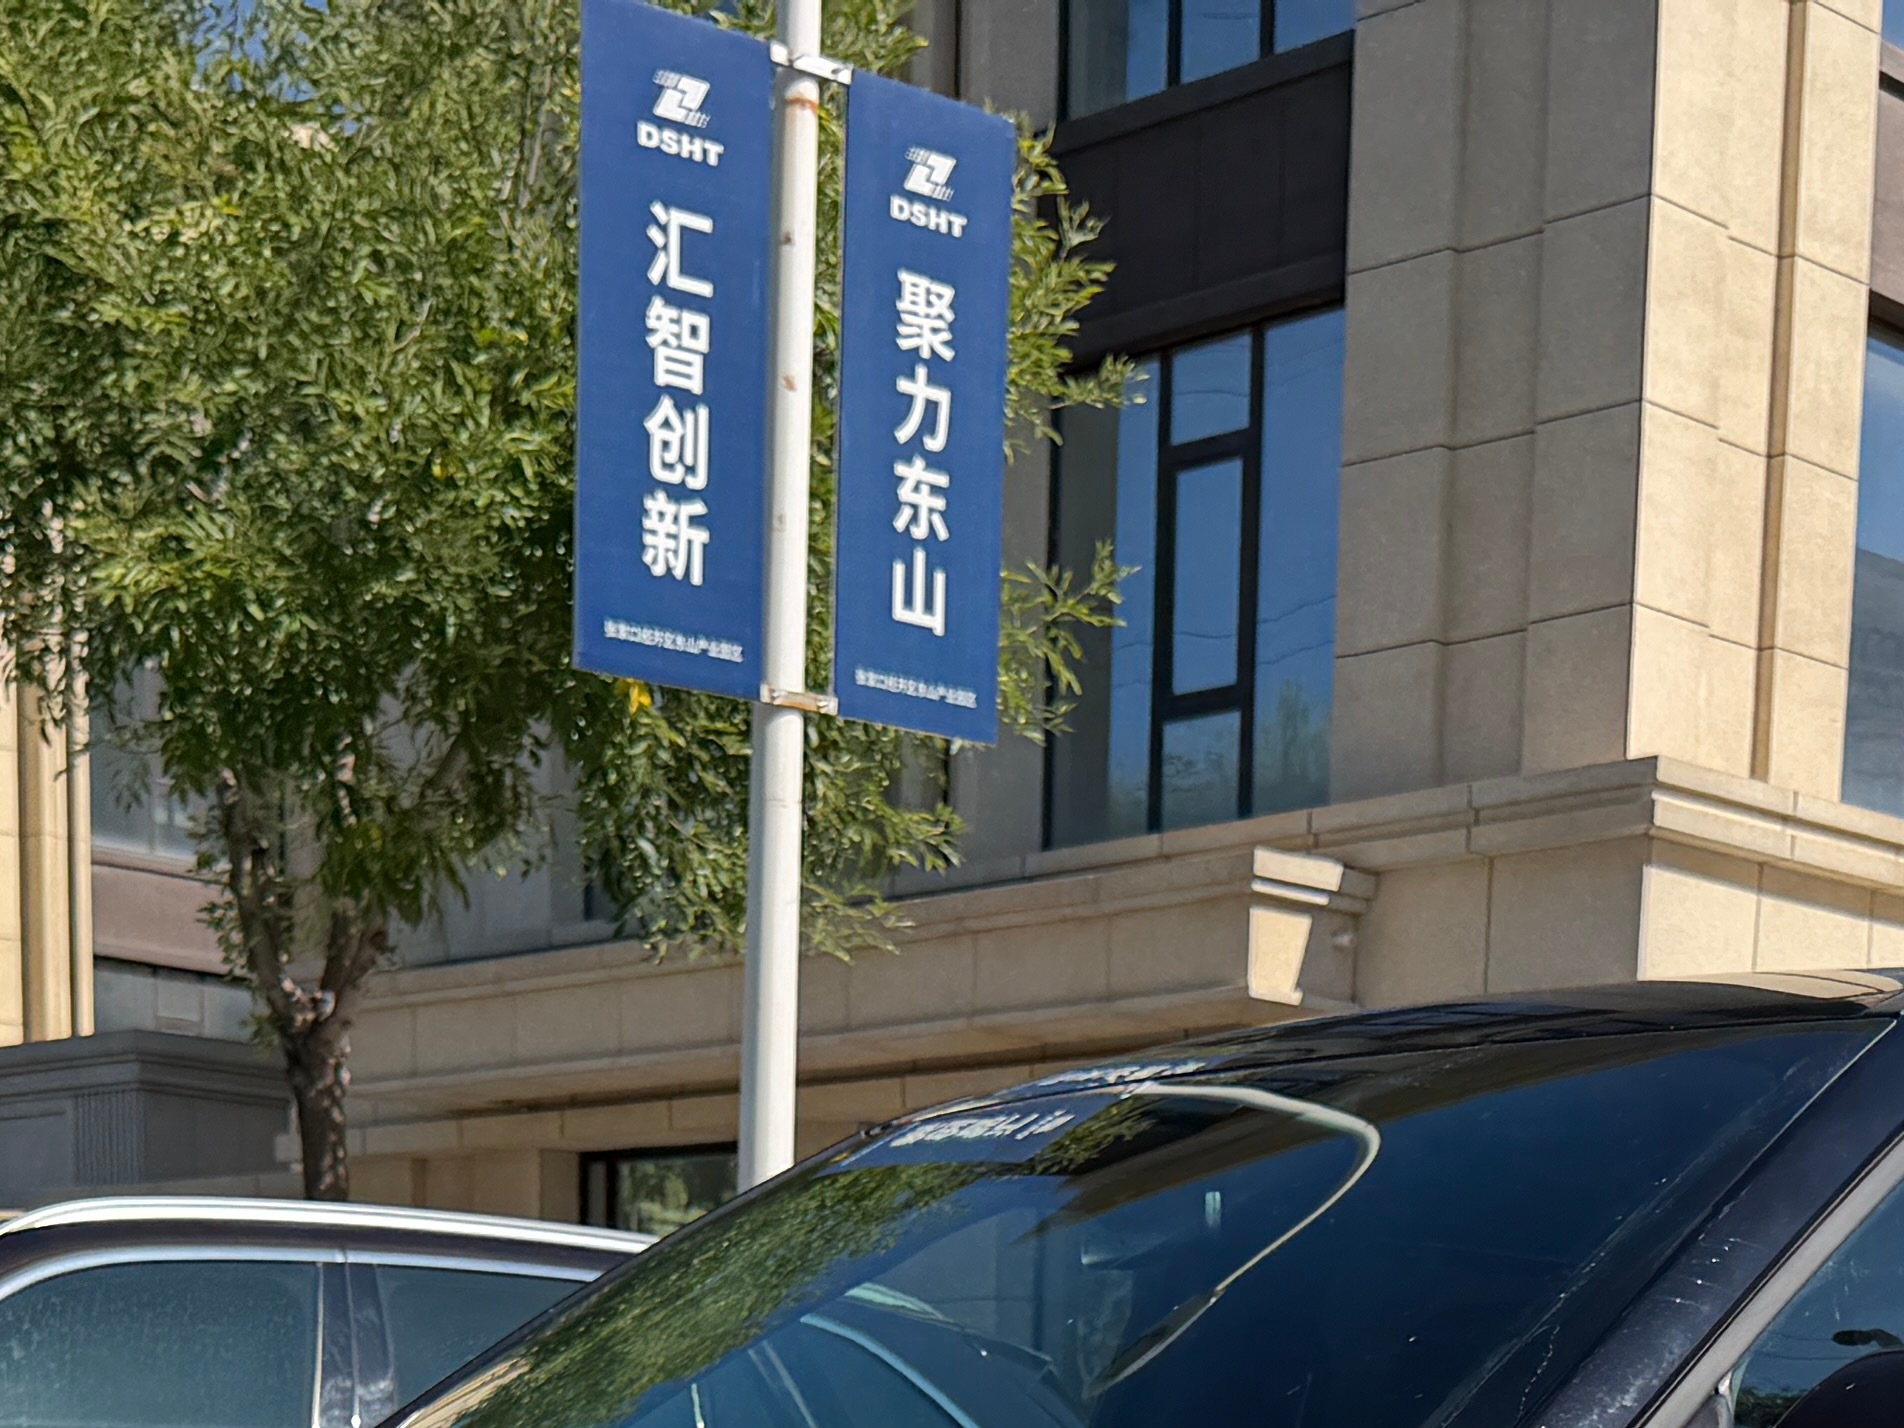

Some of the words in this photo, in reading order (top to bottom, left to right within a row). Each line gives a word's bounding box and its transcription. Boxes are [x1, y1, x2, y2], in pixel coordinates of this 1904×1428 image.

[636, 121, 725, 167] DSHT
[889, 194, 968, 238] DSHT
[642, 200, 715, 588] 汇智创新
[890, 268, 956, 638] 聚力东山
